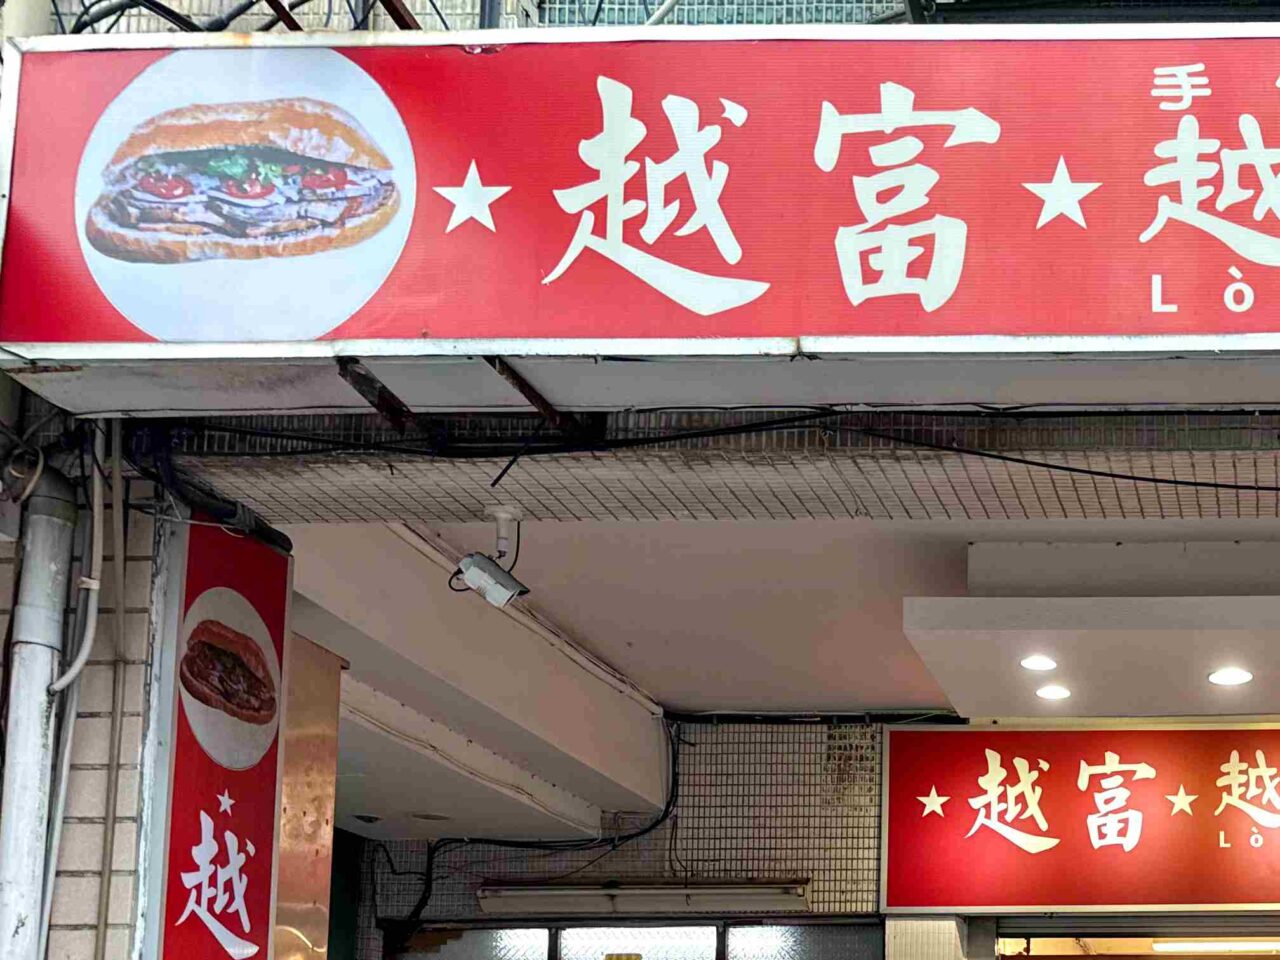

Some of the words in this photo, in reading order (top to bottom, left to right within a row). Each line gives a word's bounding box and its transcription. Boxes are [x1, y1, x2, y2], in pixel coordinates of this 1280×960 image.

[542, 76, 1001, 316] 越富
[1151, 268, 1254, 312] Lò
[964, 748, 1160, 854] 越富
[1219, 828, 1263, 848] Lò
